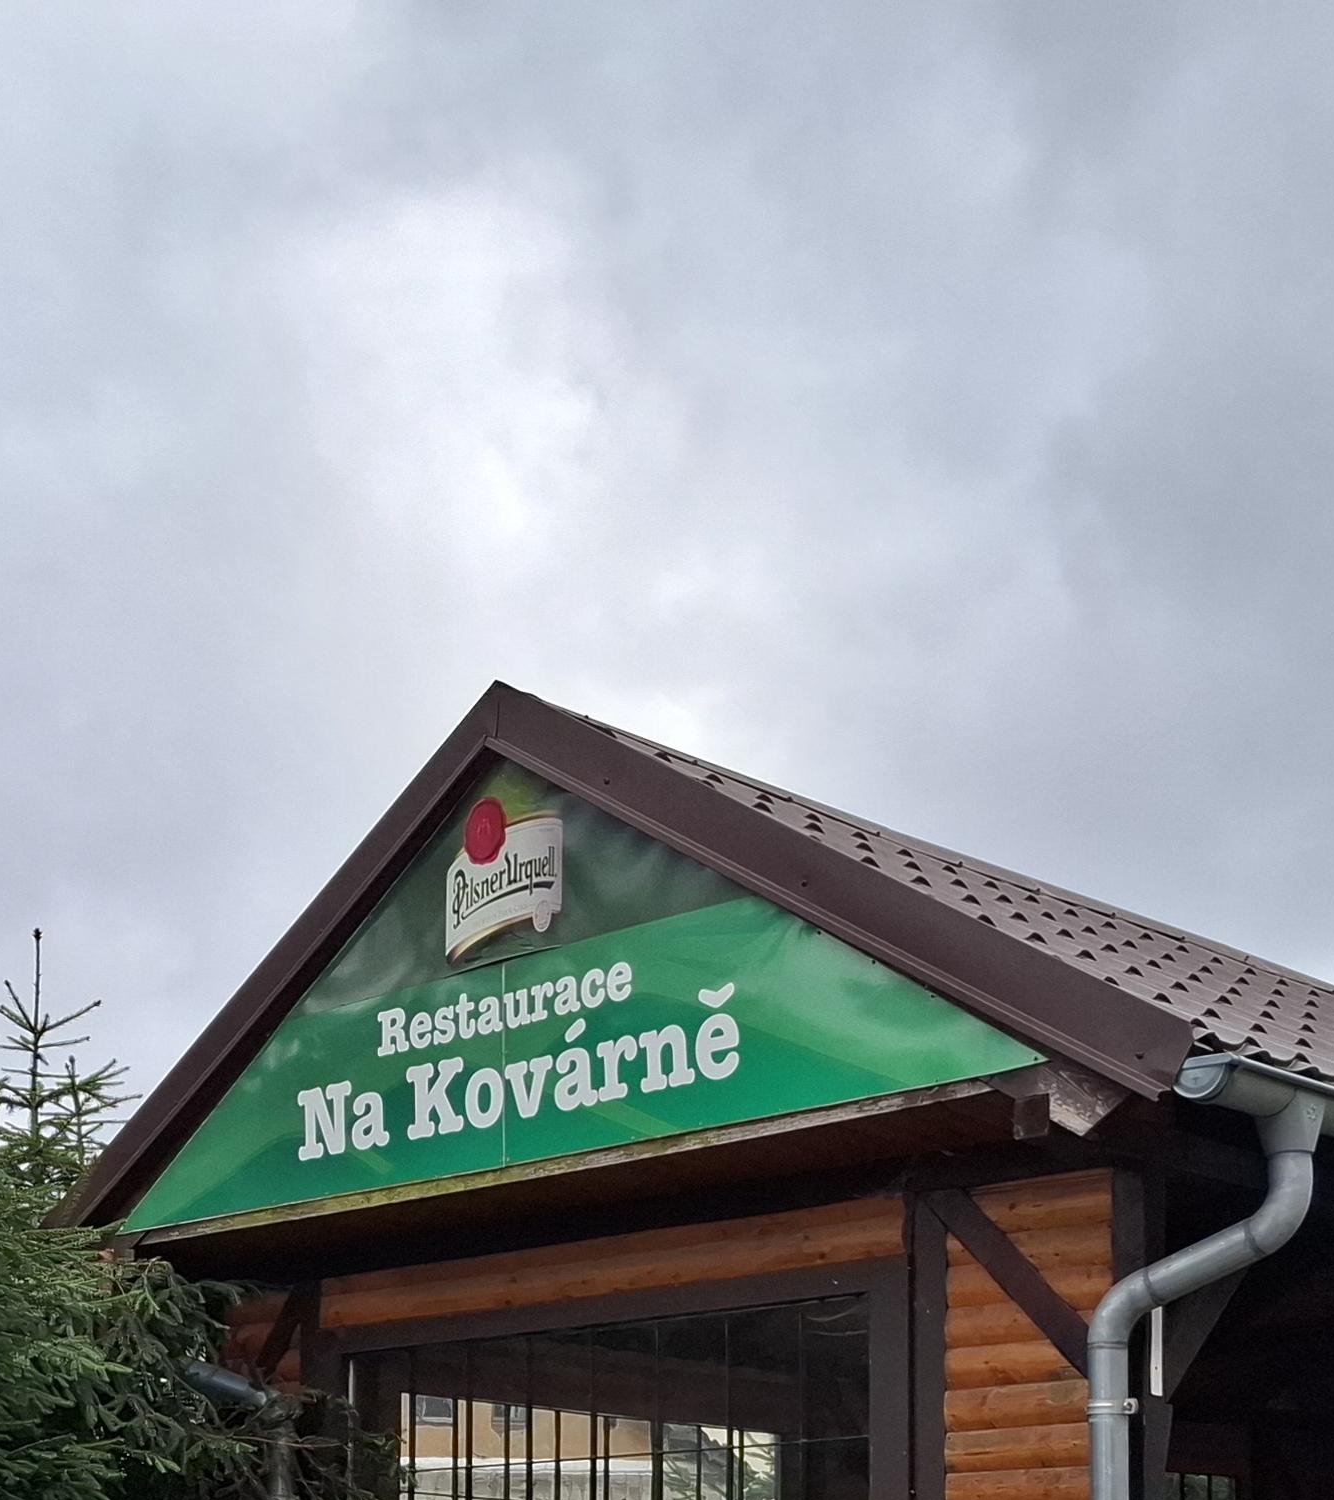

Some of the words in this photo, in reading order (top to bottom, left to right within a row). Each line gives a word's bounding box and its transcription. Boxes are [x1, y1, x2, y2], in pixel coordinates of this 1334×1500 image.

[452, 868, 506, 929] Pilsner
[377, 961, 633, 1057] Restaurace
[298, 1080, 390, 1161] Na
[406, 982, 740, 1140] Kovárně
